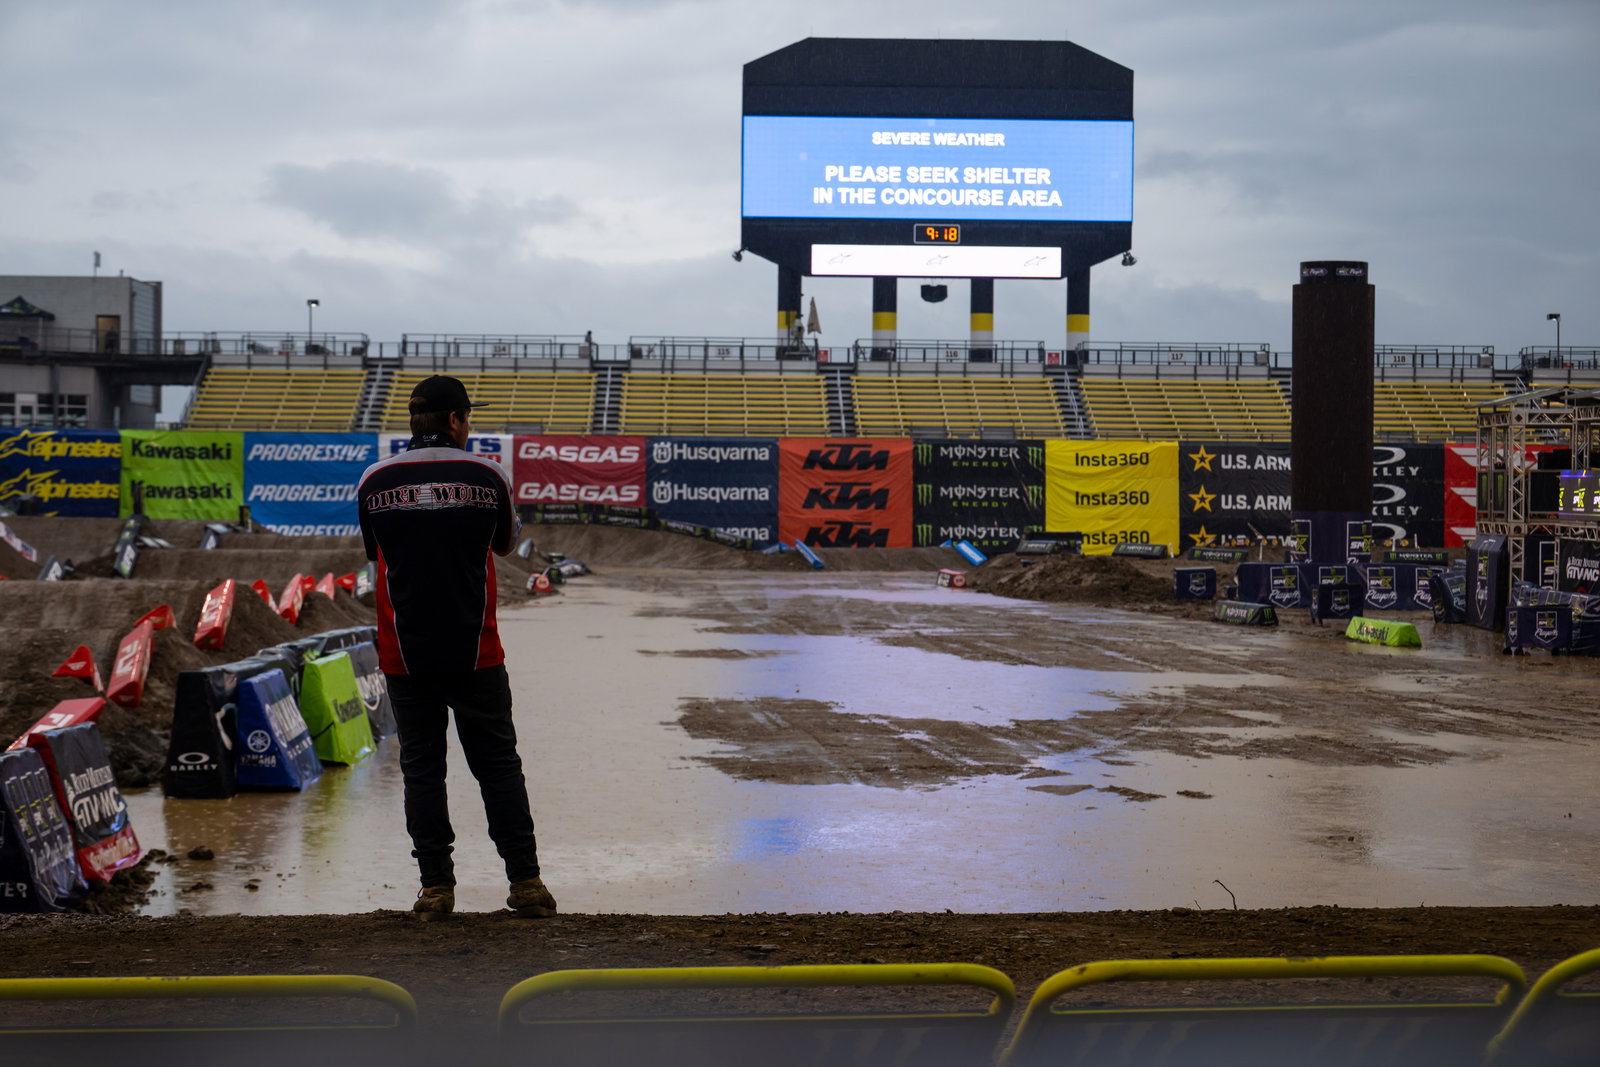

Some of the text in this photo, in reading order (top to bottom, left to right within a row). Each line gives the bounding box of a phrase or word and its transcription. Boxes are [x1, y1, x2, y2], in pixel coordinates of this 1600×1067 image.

[872, 132, 1005, 147] SEVERE WEATHER
[825, 166, 1051, 185] PLEASE SEEK SHELTER
[813, 187, 1062, 207] IN THE CONCOURSE AREA
[926, 227, 957, 241] 9:18
[1171, 352, 1183, 361] 117
[33, 438, 122, 461] alpinestars
[131, 439, 232, 460] Kawasaki
[247, 444, 373, 462] PROGRESSIVE
[390, 438, 501, 454] PTS
[518, 442, 640, 463] GASGAS
[673, 443, 769, 463] Husqvarna
[940, 444, 1020, 460] MONSTER
[802, 444, 890, 470] KTM
[1075, 452, 1149, 466] Insta360
[1221, 454, 1292, 471] U.S. ARM
[1372, 466, 1420, 476] KLEY
[33, 479, 120, 502] alpinestars
[248, 484, 359, 502] PROGRESSIV
[366, 485, 499, 511] DIRT WURX
[518, 482, 640, 502] GASGAS
[673, 483, 769, 503] Husqvarna
[802, 482, 890, 510] KTM
[940, 484, 1020, 500] MONSTER
[1075, 491, 1150, 505] Insta360
[1221, 494, 1292, 511] U.S. ARM
[1372, 505, 1420, 516] KLEY
[804, 521, 890, 548] KTM
[940, 524, 1020, 539] MONSTER
[1082, 531, 1150, 545] nsta360
[170, 763, 218, 771] OAKLEY
